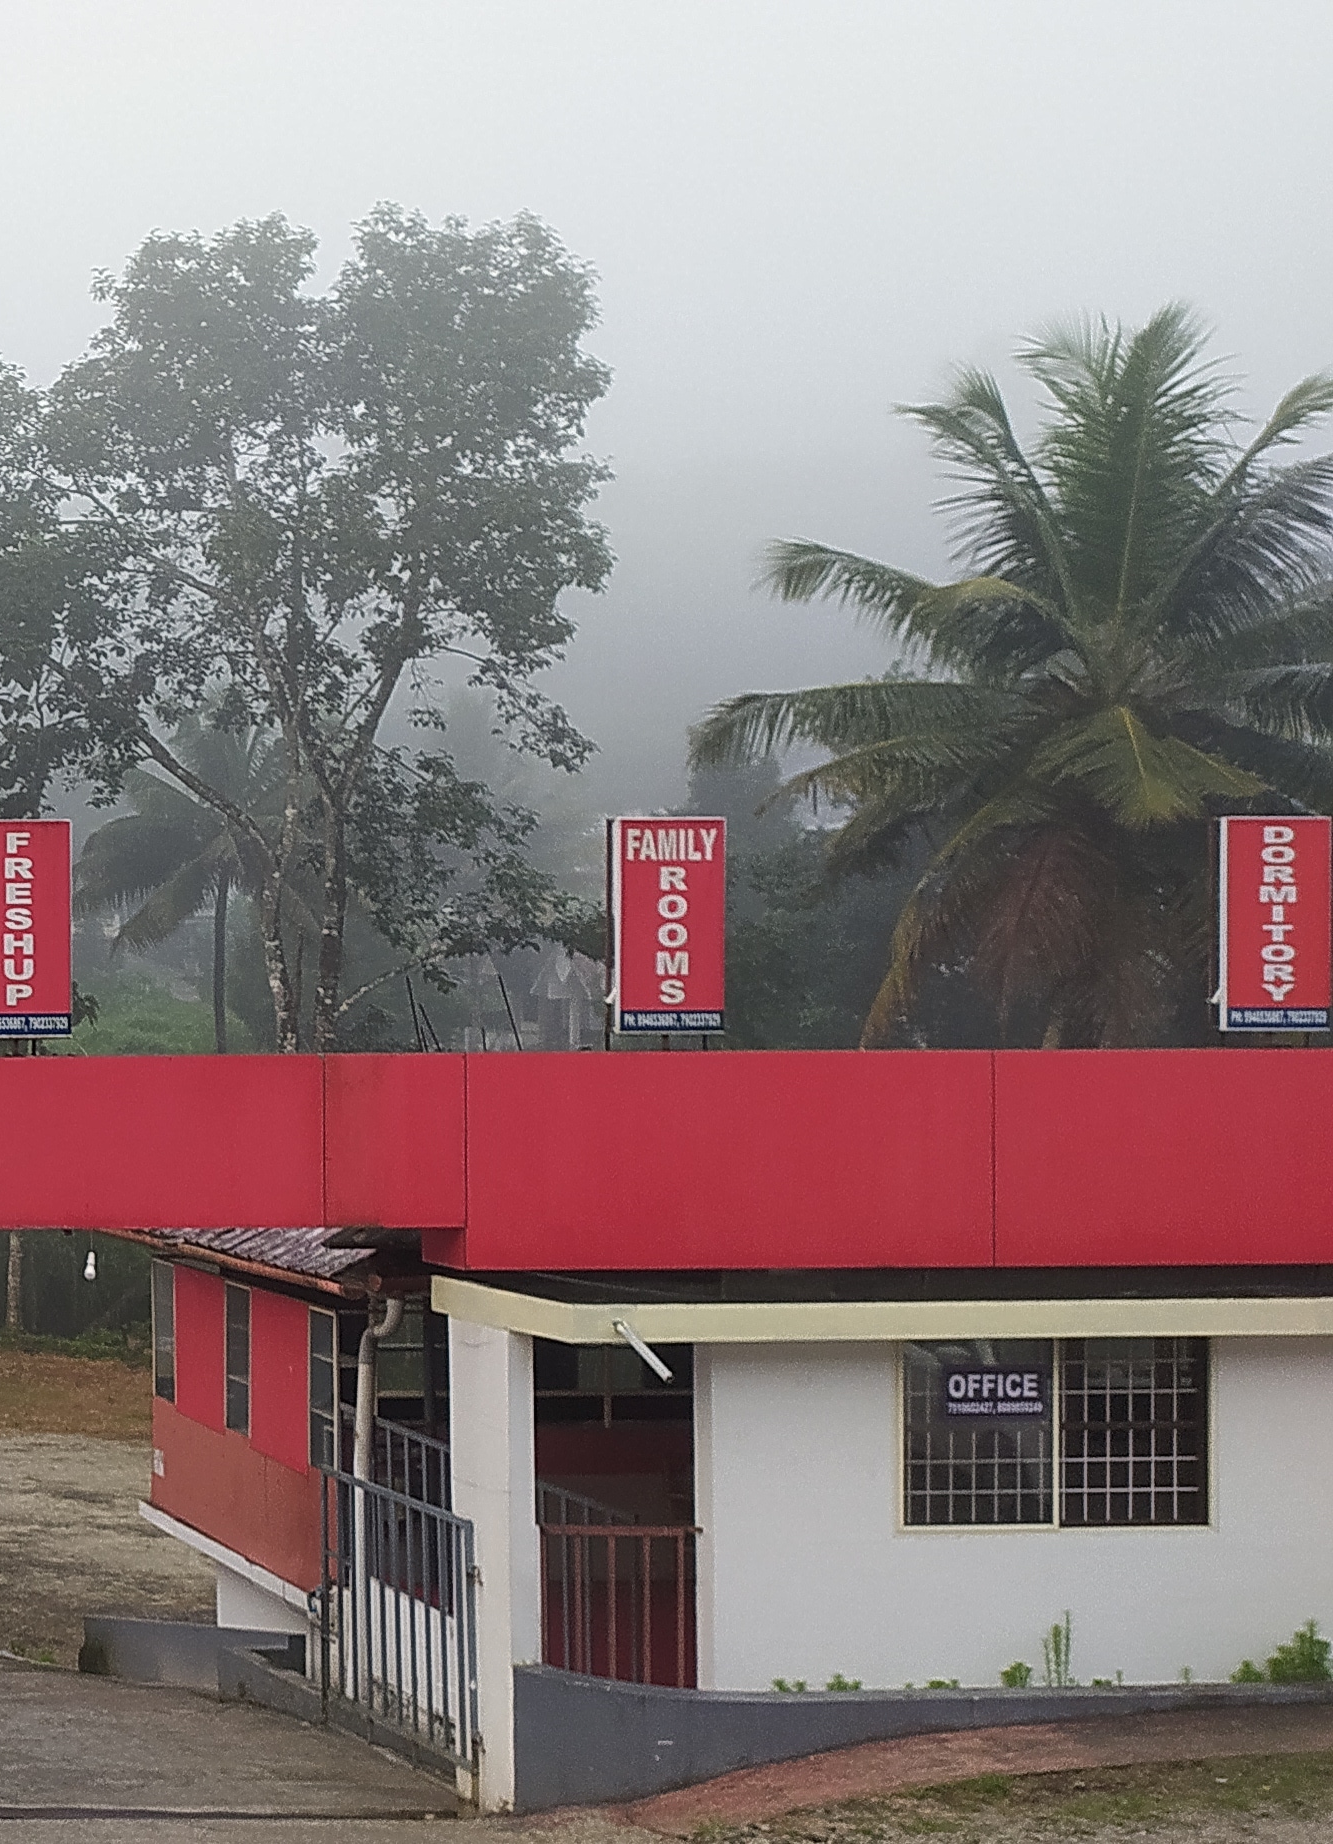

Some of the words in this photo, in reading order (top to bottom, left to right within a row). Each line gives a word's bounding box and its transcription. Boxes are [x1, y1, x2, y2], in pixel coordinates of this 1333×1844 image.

[625, 827, 719, 862] FAMILY
[2, 832, 35, 1006] FRESHUP
[655, 866, 690, 1004] ROOMS
[1258, 826, 1299, 1002] DORMITORY
[948, 1373, 1039, 1399] OFFICE
